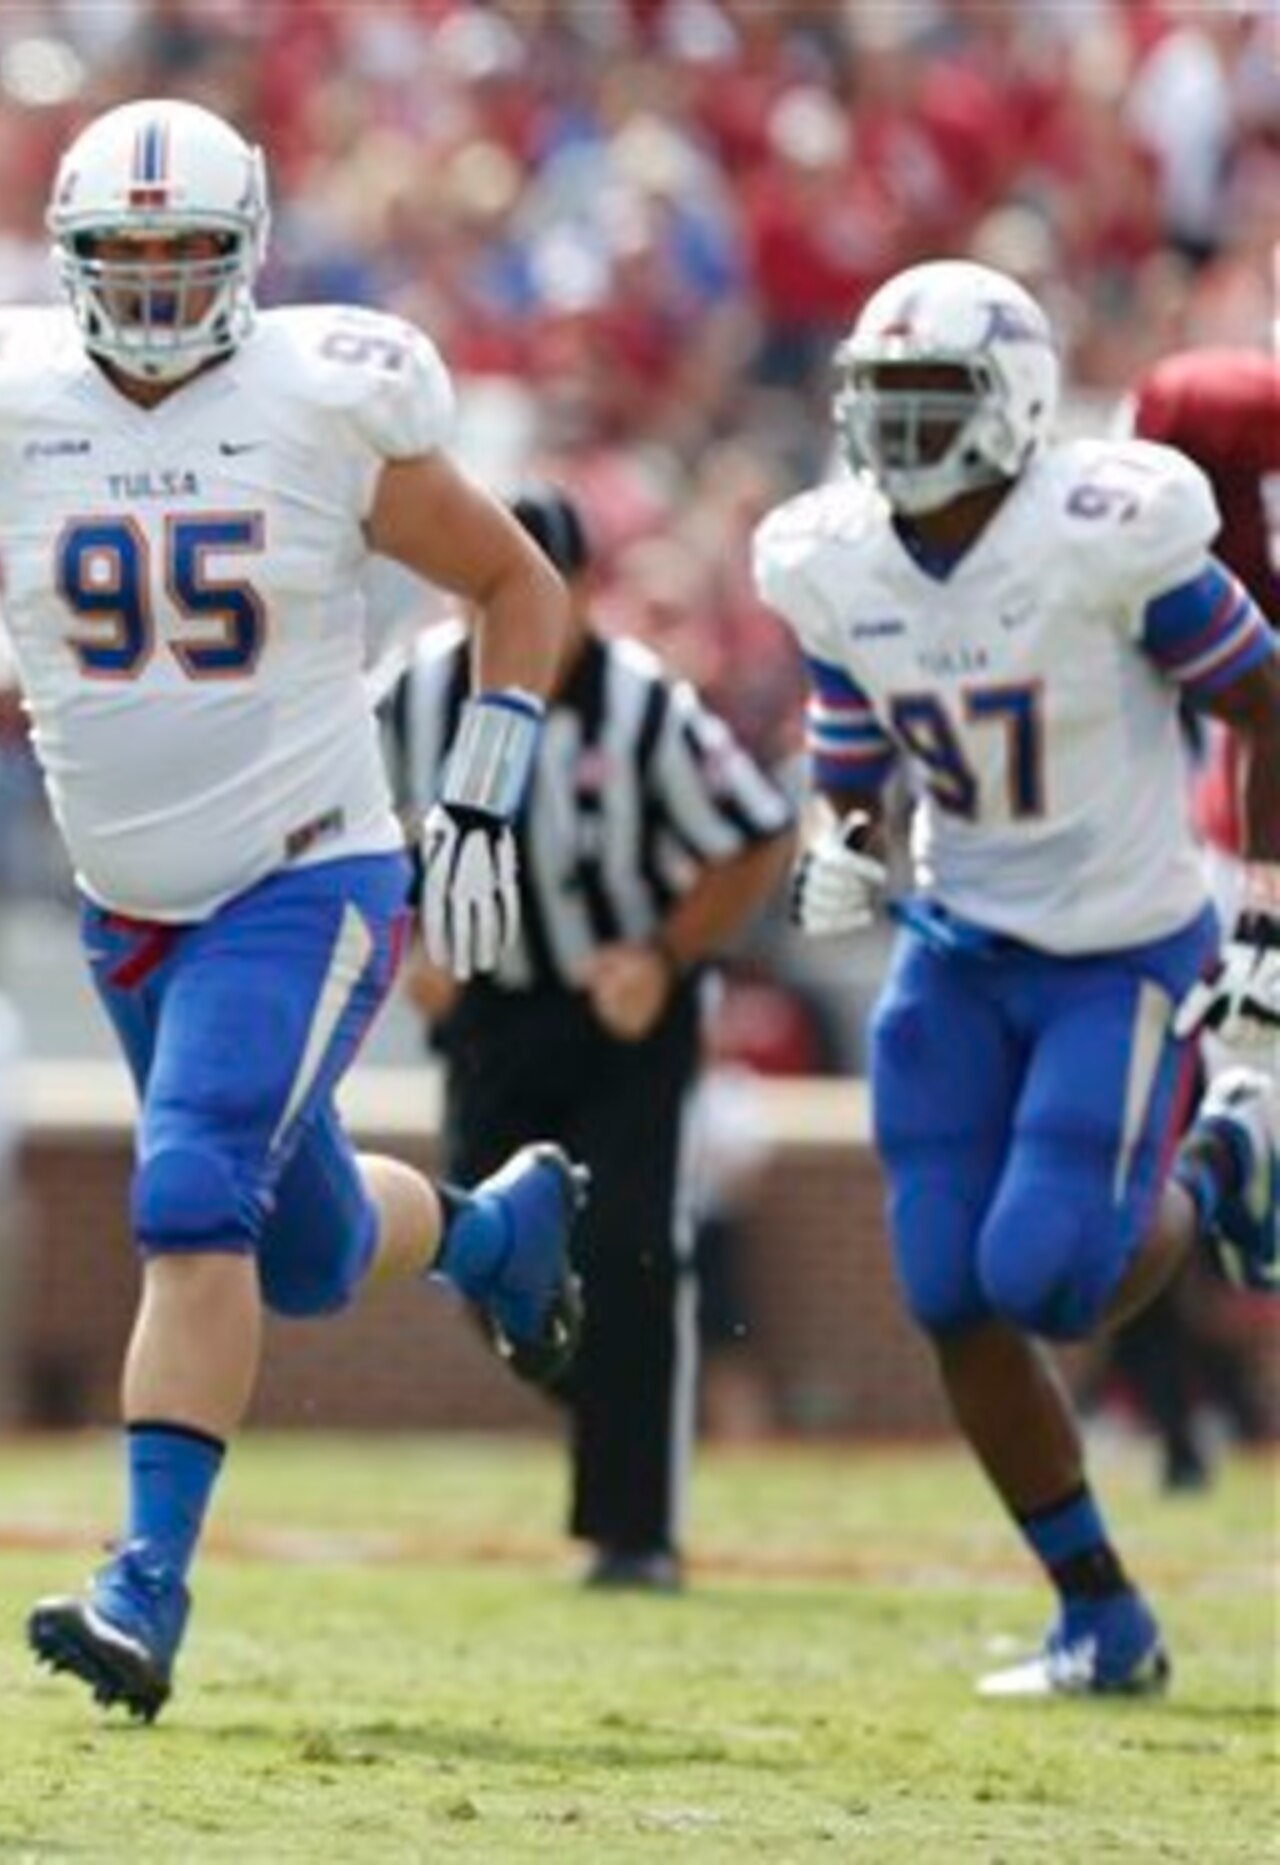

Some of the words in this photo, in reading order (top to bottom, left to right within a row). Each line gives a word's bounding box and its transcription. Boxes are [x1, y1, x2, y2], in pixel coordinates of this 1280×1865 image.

[106, 470, 199, 498] TULSA
[57, 512, 267, 681] 95
[887, 680, 1046, 822] 97
